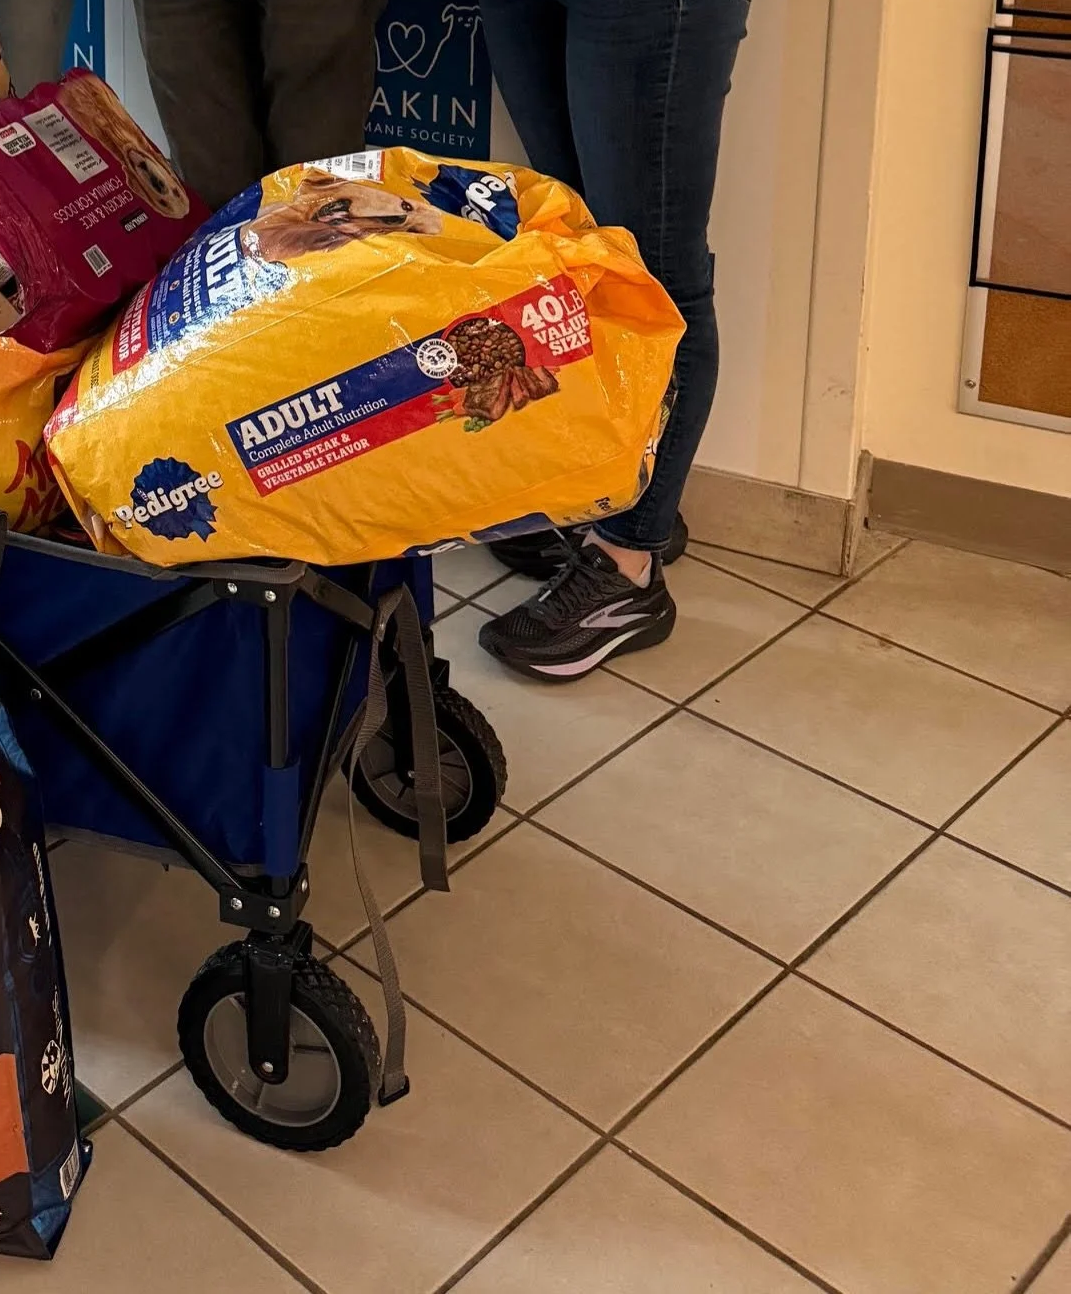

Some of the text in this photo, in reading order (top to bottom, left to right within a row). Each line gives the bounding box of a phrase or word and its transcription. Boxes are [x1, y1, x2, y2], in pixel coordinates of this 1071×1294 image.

[369, 86, 476, 129] AKIN
[410, 128, 475, 148] SOCIETY
[53, 175, 123, 224] FORMULA FOR DOGS
[78, 189, 134, 230] CHICKEN & RICE
[521, 288, 586, 333] 40 LB
[533, 313, 590, 346] VALUE
[550, 328, 591, 357] SIZE
[238, 382, 344, 449] ADULT
[249, 396, 388, 463] Complete Adult Nutrition
[257, 433, 351, 479] GRILLED STEAK &
[262, 438, 371, 491] VEGETABLE FLAVOR
[115, 467, 225, 529] Pedigree
